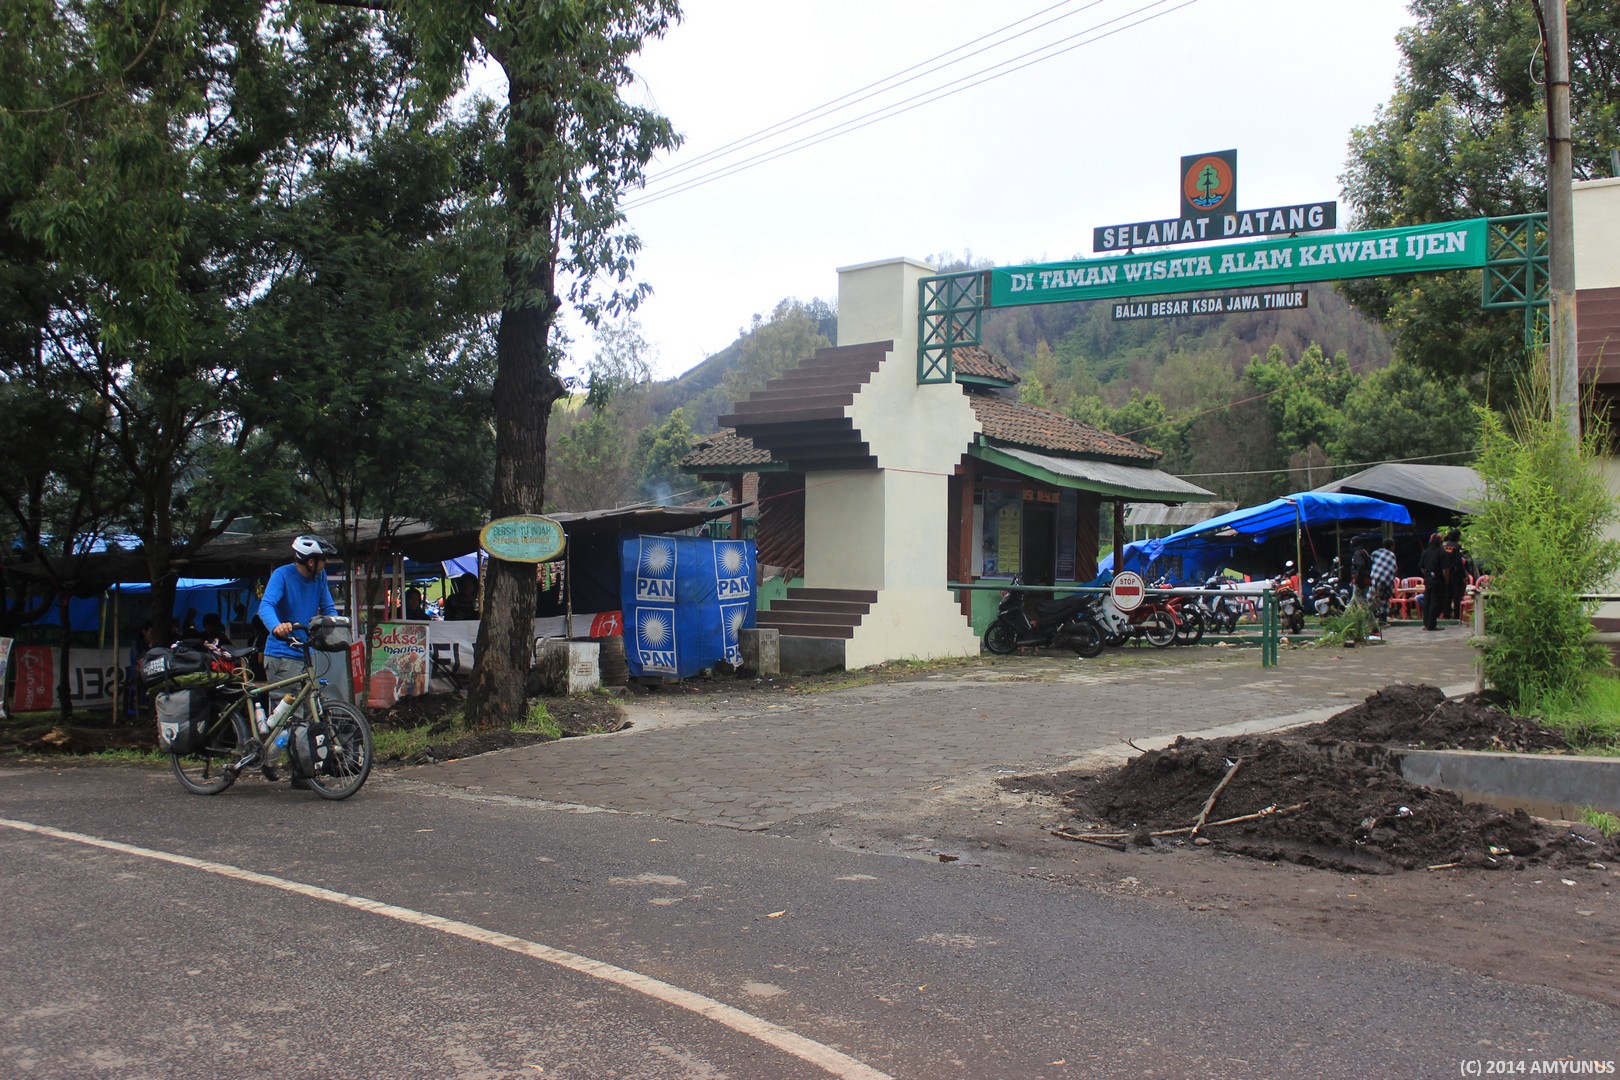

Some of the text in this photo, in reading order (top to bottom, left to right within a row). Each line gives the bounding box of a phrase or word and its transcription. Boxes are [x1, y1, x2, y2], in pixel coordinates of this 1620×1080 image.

[1103, 206, 1324, 248] SELAMAT DATANG
[1010, 230, 1467, 291] DI TAMAN WISATA ALAM KAWAH IJEN
[1115, 292, 1303, 318] BALAI BESAR KSDA JAWA TIMUR
[638, 579, 673, 597] PAN
[719, 577, 749, 596] PAN
[371, 627, 417, 649] Bakso
[640, 651, 675, 668] PAN
